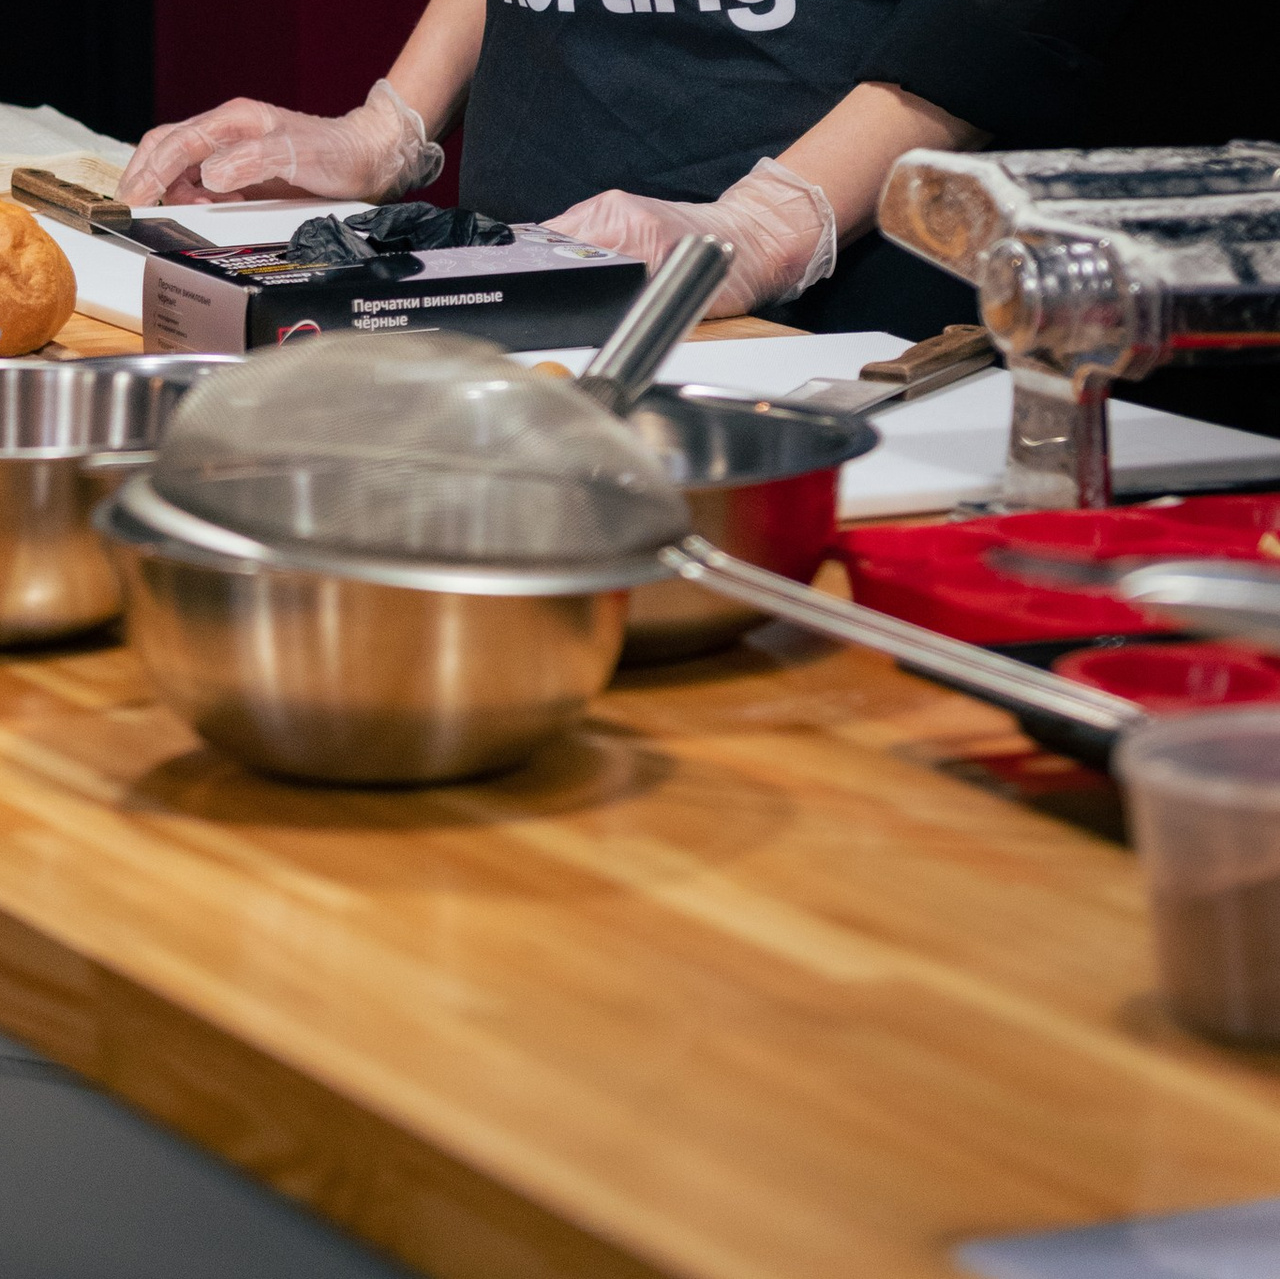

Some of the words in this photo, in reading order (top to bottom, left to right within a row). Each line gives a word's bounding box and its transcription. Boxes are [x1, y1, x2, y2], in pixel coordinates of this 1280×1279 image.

[352, 298, 420, 314] Перчатки
[422, 291, 504, 308] виниловые
[353, 315, 409, 331] чёрные
